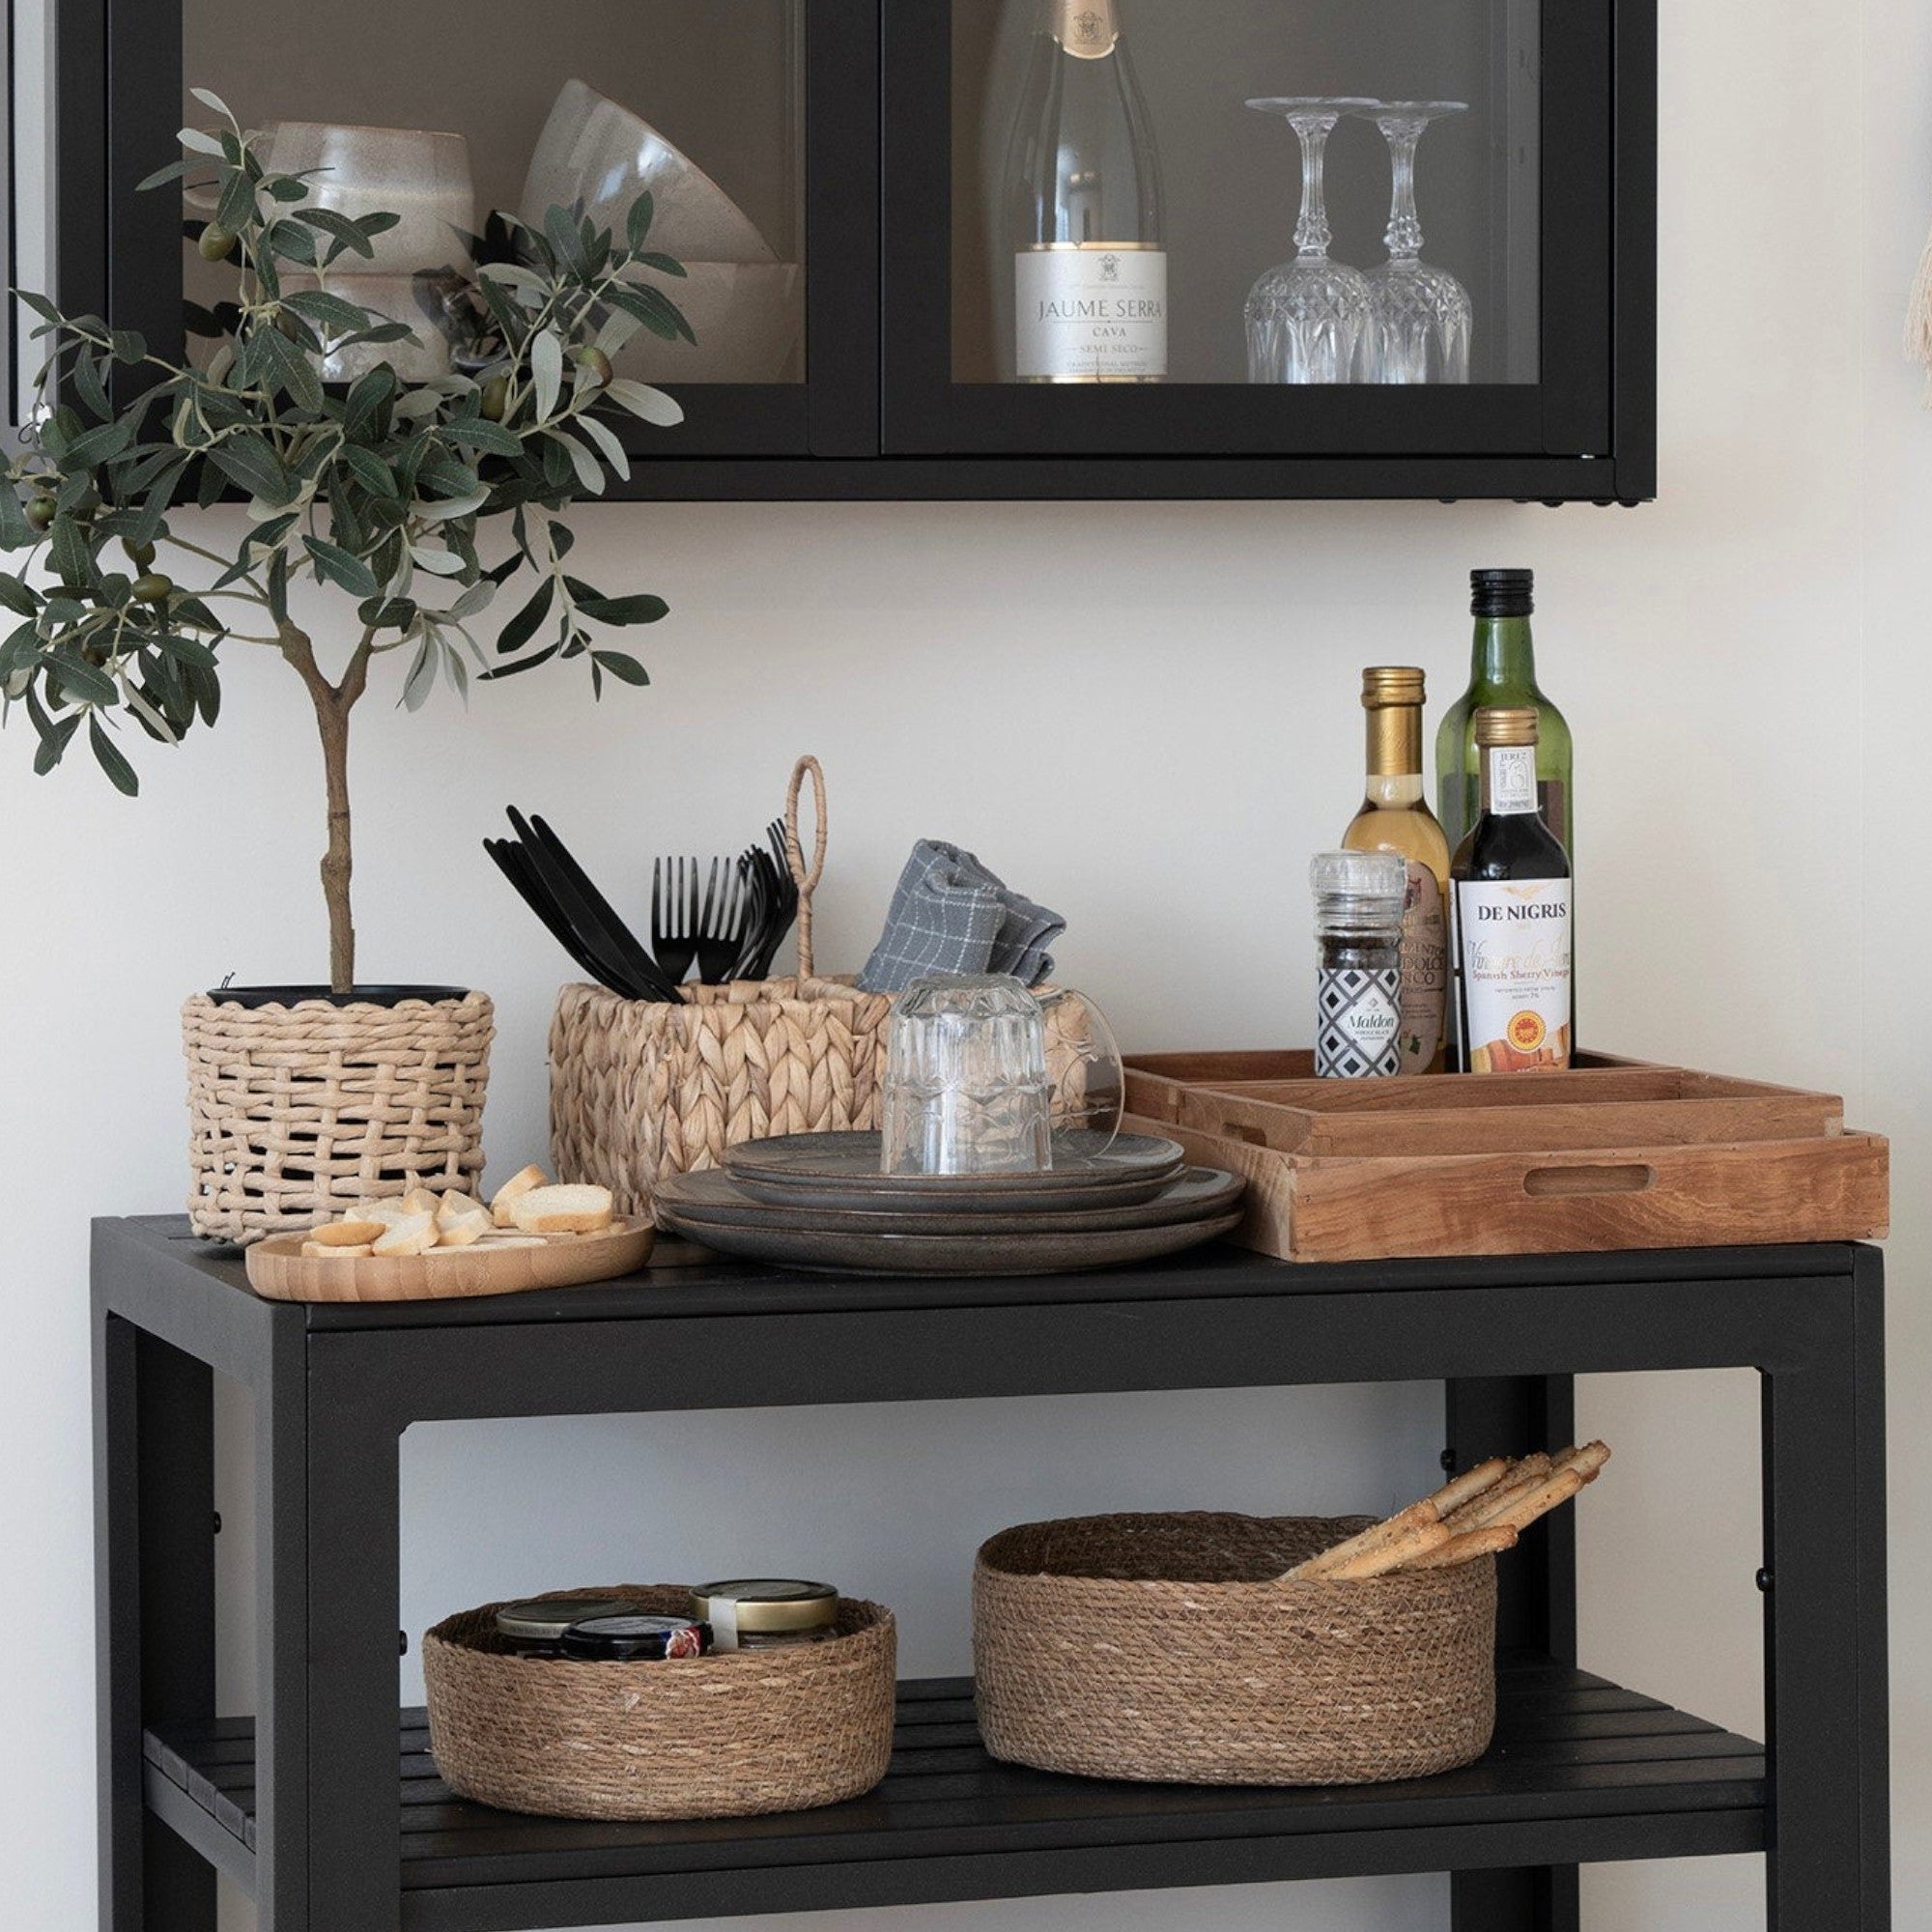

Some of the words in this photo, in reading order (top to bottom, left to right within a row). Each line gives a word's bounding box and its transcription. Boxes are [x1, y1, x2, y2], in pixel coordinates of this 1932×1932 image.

[1037, 299, 1110, 322] JAUME
[1116, 299, 1162, 318] SERRA
[1093, 327, 1126, 337] CAVA
[1080, 345, 1107, 354] SEMI
[1112, 345, 1138, 354] SECO
[1478, 906, 1503, 922] DE
[1508, 903, 1567, 920] NIGRIS
[1473, 969, 1507, 980] Spanish
[1510, 969, 1541, 980] Sherry
[1348, 1013, 1394, 1029] Maldon
